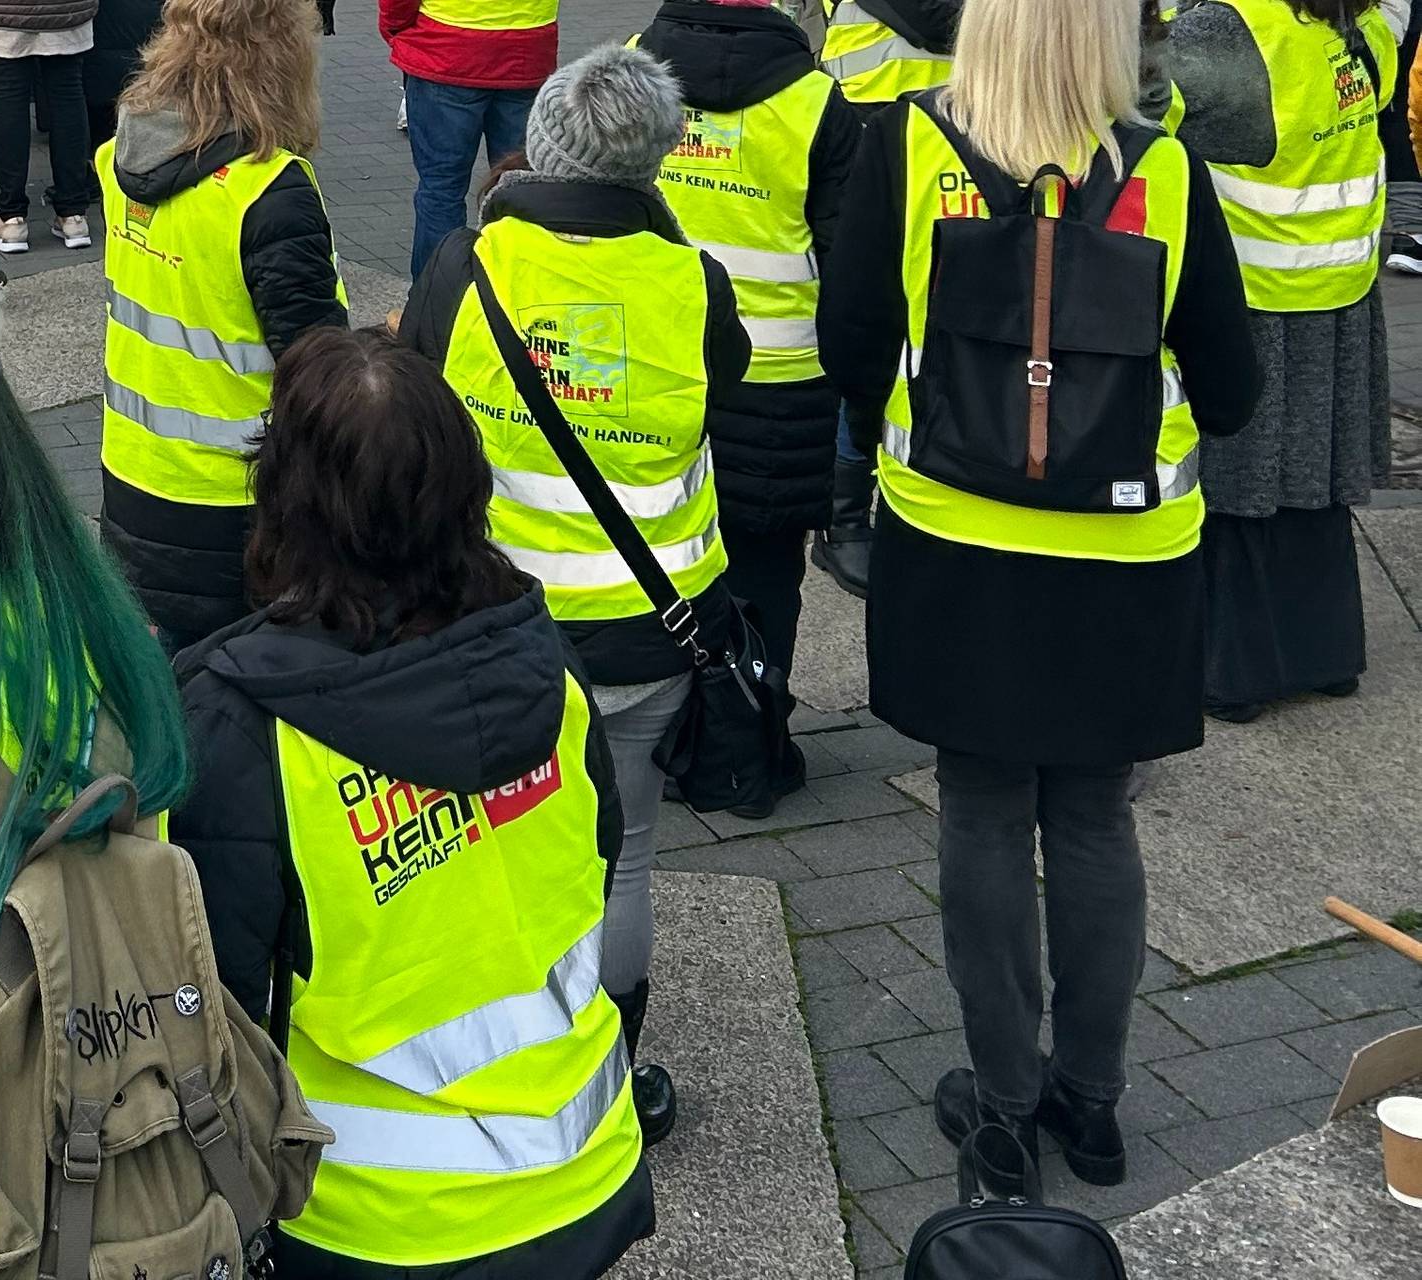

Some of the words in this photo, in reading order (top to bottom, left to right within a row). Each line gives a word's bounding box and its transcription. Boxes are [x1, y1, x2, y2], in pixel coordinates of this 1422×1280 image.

[671, 144, 731, 160] SCHÄFT
[658, 170, 682, 183] UNS
[685, 174, 715, 190] KEIN
[539, 366, 570, 387] EIN
[549, 383, 613, 403] CHÄFT
[465, 395, 505, 420] OHNE
[594, 429, 671, 447] HANDEL!
[374, 832, 463, 907] GESCHÄFT
